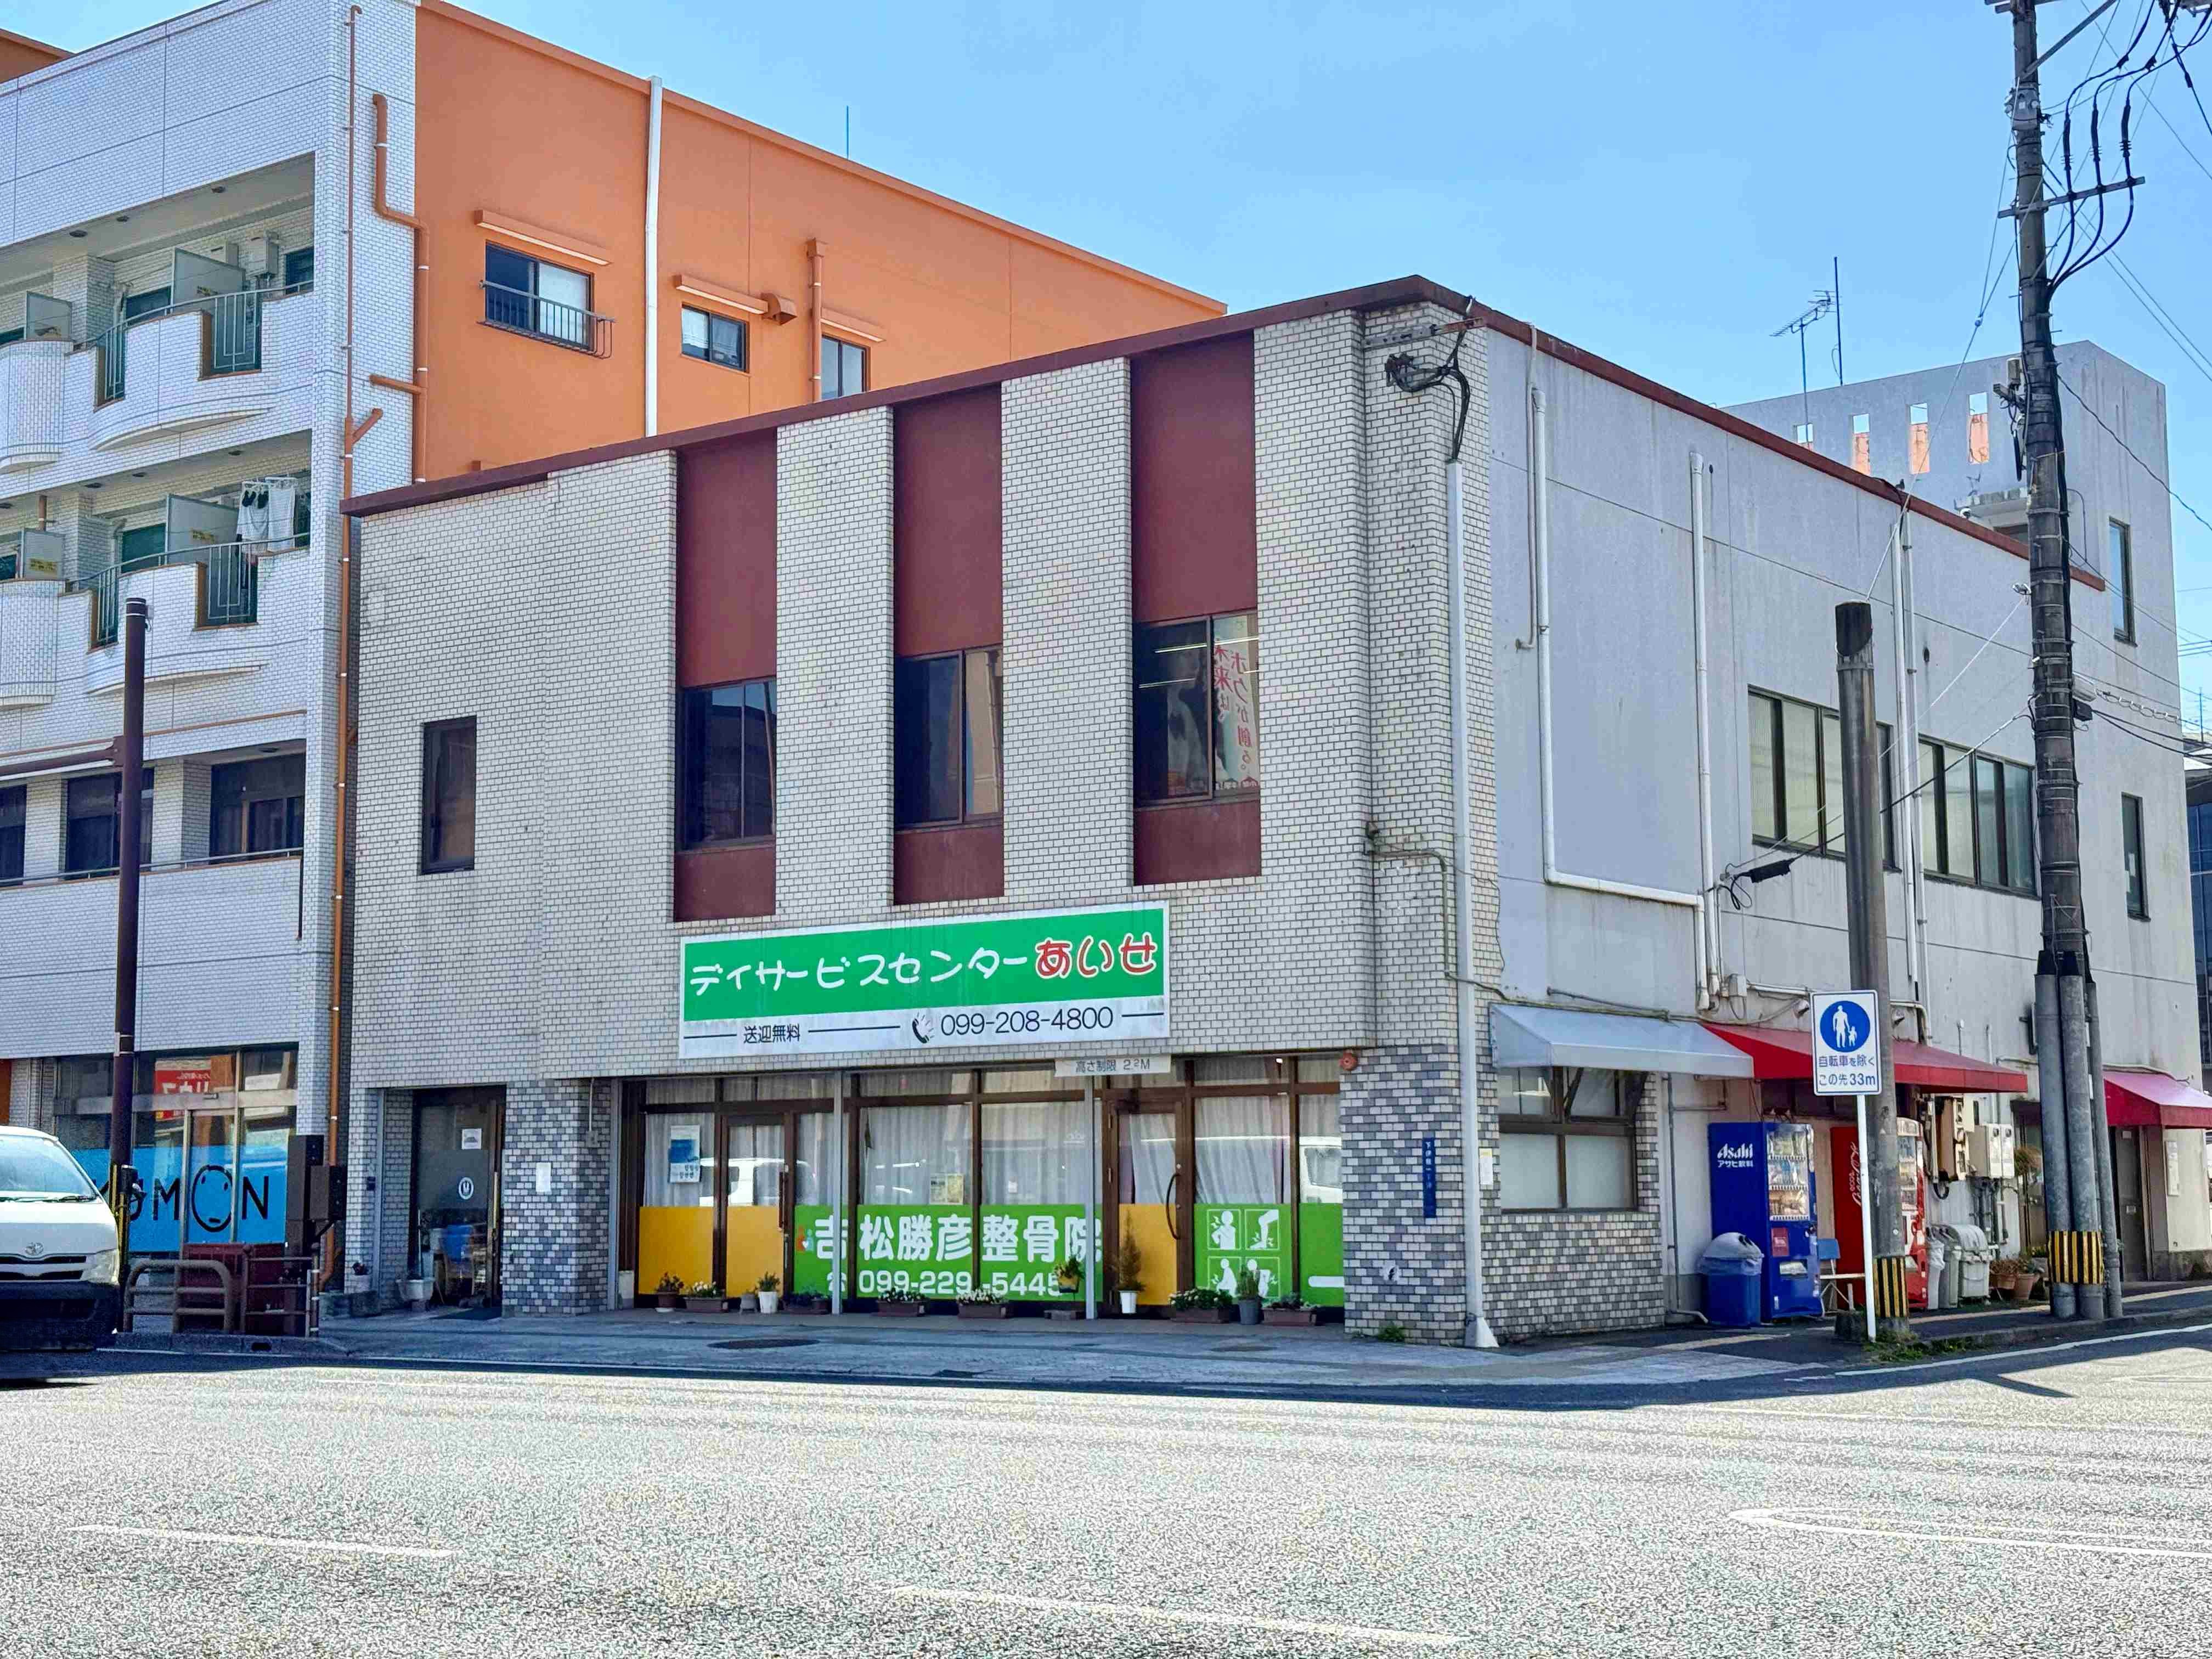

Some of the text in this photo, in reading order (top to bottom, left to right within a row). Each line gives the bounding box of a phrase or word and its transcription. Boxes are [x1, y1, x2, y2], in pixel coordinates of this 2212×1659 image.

[941, 1006, 1114, 1037] 099-208-4800
[743, 1023, 800, 1044] 送迎無料
[1076, 1059, 1116, 1073] 高さ制限
[1819, 1054, 1875, 1068] 自転車を除く
[1717, 1143, 1753, 1159] Asahi
[1717, 1160, 1754, 1168] アサヒ飲料
[96, 1165, 269, 1233] MON
